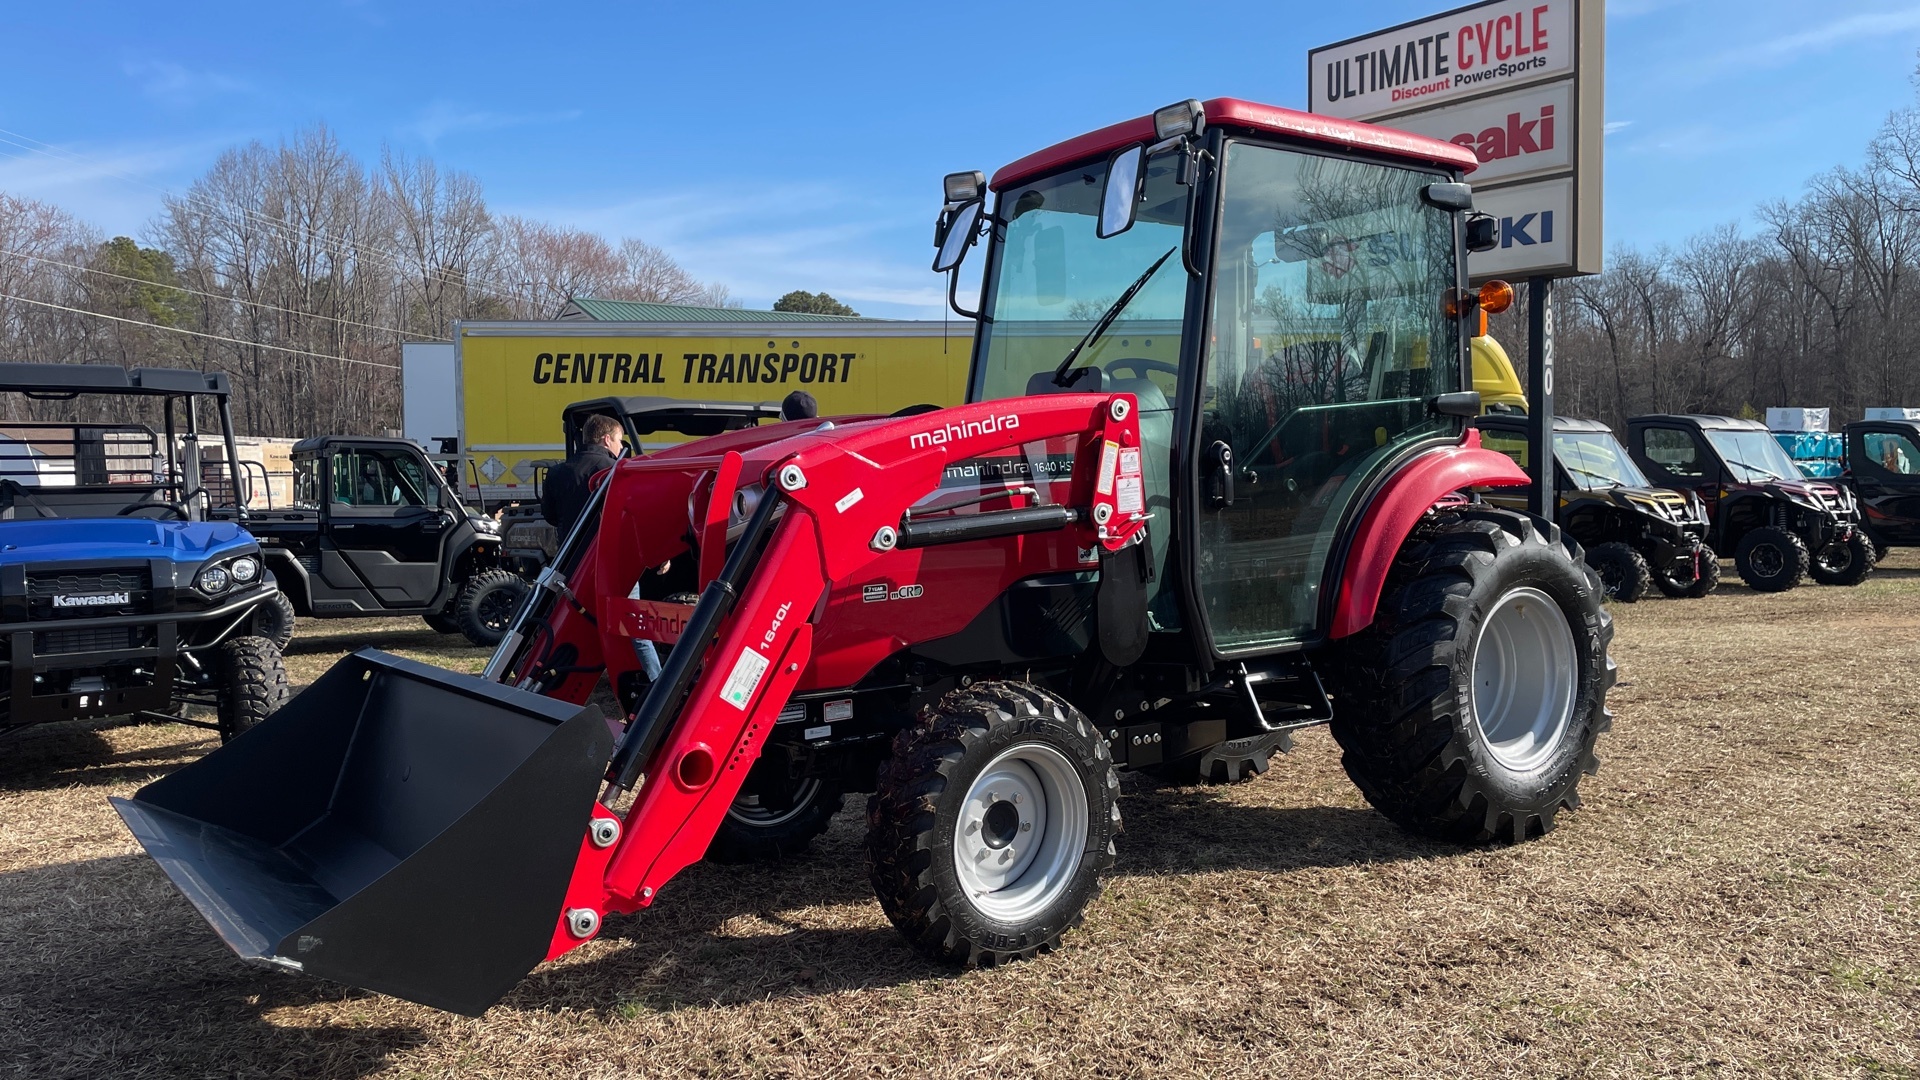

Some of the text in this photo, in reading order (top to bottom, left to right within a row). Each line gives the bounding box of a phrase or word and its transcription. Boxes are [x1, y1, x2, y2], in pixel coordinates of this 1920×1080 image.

[1327, 4, 1549, 102] ULTIMATE CYCLE
[1391, 55, 1547, 102] Discount PowerSports
[1449, 104, 1555, 163] saki
[532, 352, 857, 384] CENTRAL TRANSPORT
[910, 414, 1020, 449] mahindra
[946, 460, 1030, 478] mahindra
[1034, 461, 1057, 472] 1640
[54, 592, 129, 607] Kawasaki
[760, 601, 792, 649] 1640L
